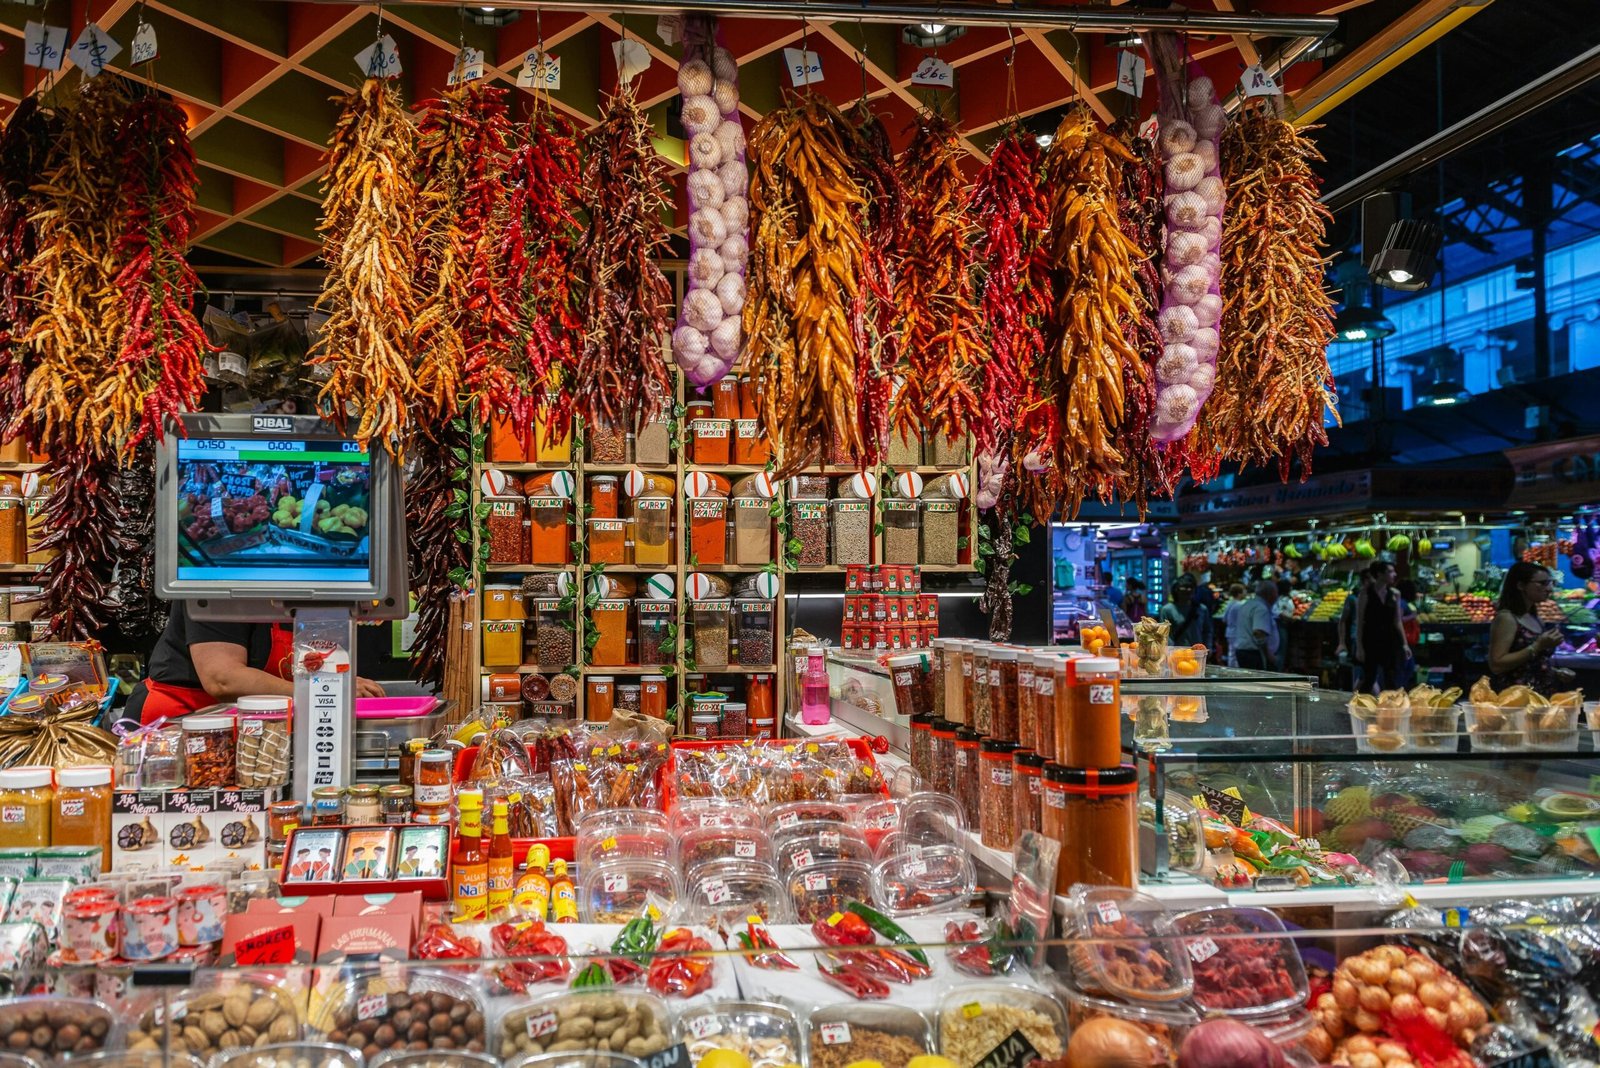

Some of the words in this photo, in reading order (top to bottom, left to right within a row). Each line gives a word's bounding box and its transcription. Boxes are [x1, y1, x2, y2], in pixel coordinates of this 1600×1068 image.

[253, 417, 292, 427] DIBAL
[639, 501, 666, 509] CURRY
[594, 522, 622, 530] PIL-PIL
[117, 793, 136, 807] Ajo
[168, 793, 188, 807] Ajo
[219, 792, 239, 806] Ajo
[130, 803, 159, 815] Negro
[182, 802, 211, 815] Negro
[233, 801, 260, 815] Negro
[458, 880, 488, 898] Nati
[488, 874, 513, 891] ativ
[236, 930, 292, 960] SMOKED
